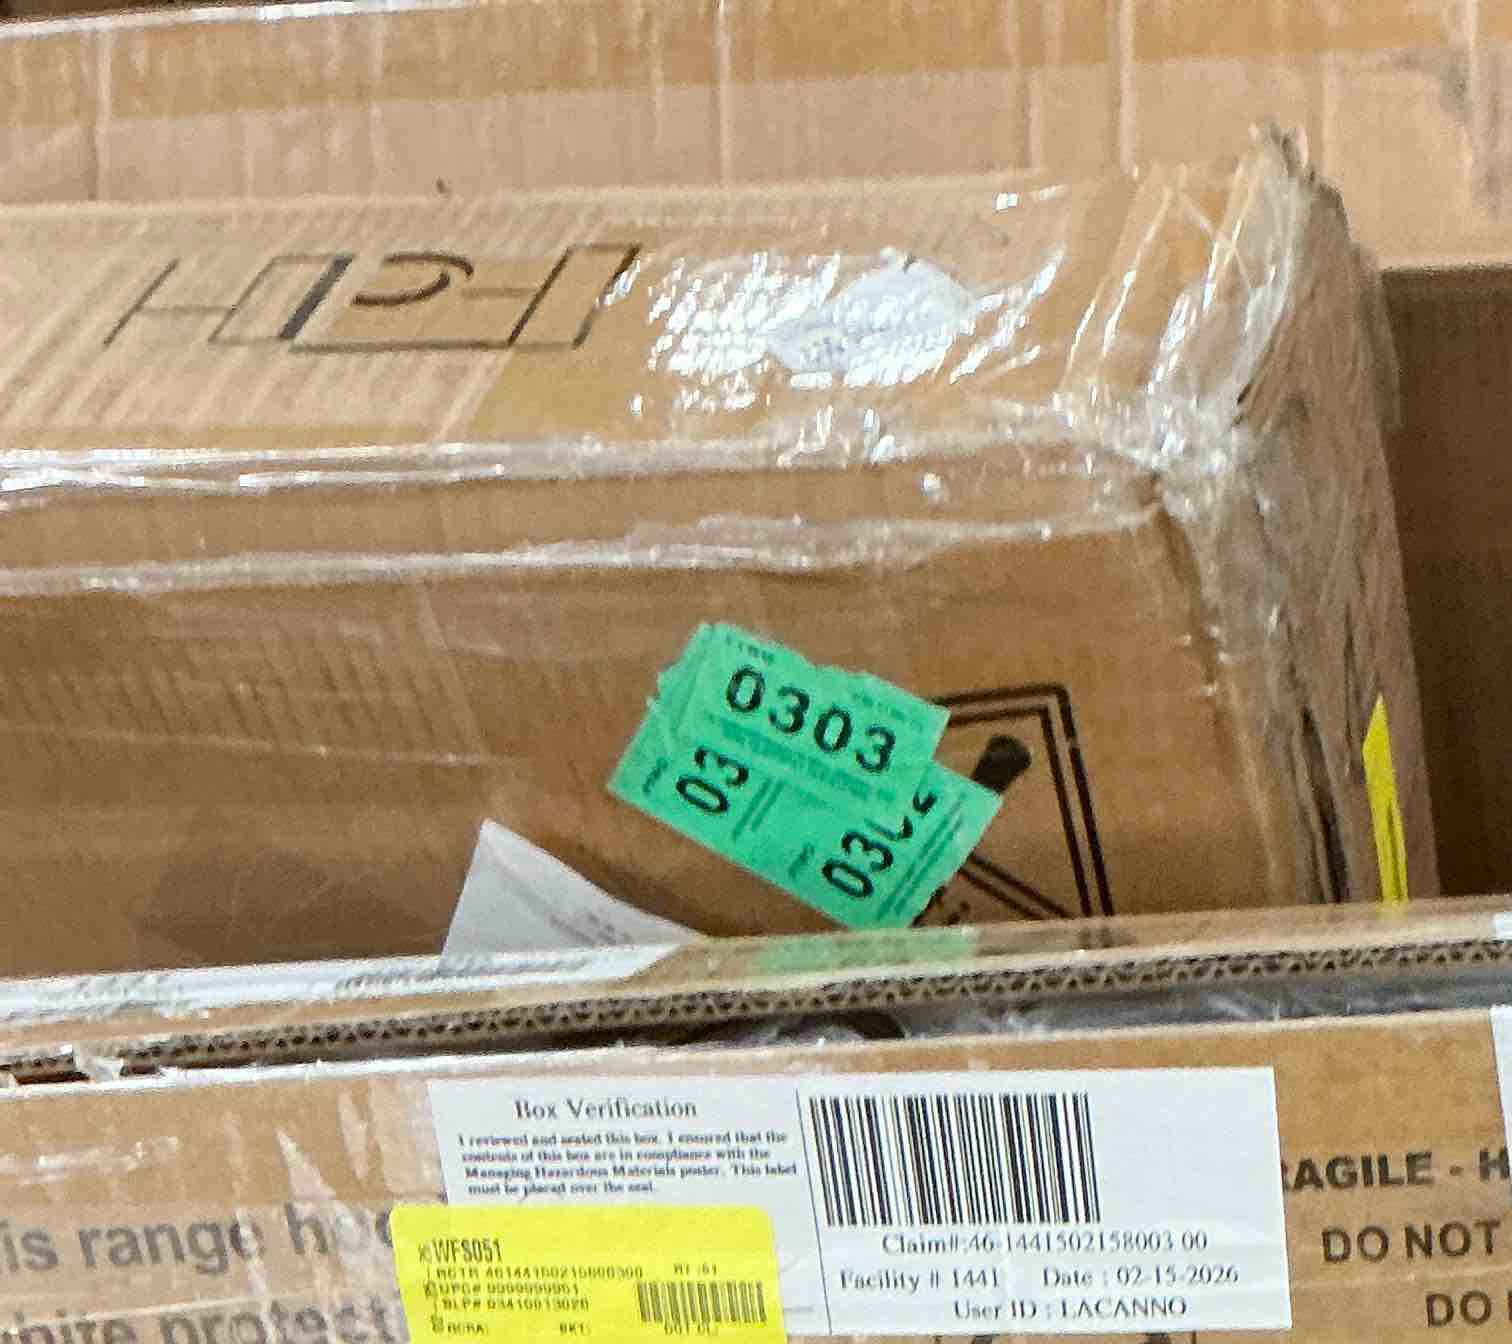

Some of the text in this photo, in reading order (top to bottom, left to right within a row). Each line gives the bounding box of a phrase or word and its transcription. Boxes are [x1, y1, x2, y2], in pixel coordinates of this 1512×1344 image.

[725, 663, 898, 776] 0303
[514, 1094, 698, 1120] Box Verification
[717, 1147, 745, 1160] with
[750, 1147, 770, 1159] the
[604, 1182, 624, 1193] the
[79, 1218, 264, 1275] range
[1321, 1225, 1389, 1264] DO
[1404, 1221, 1501, 1261] NOT
[840, 1268, 920, 1292] Facility
[952, 1268, 999, 1290] 1441
[1043, 1263, 1240, 1288] Date 02-15-2026
[953, 1296, 1188, 1322] User ID LACANNO
[1425, 1290, 1492, 1329] DO
